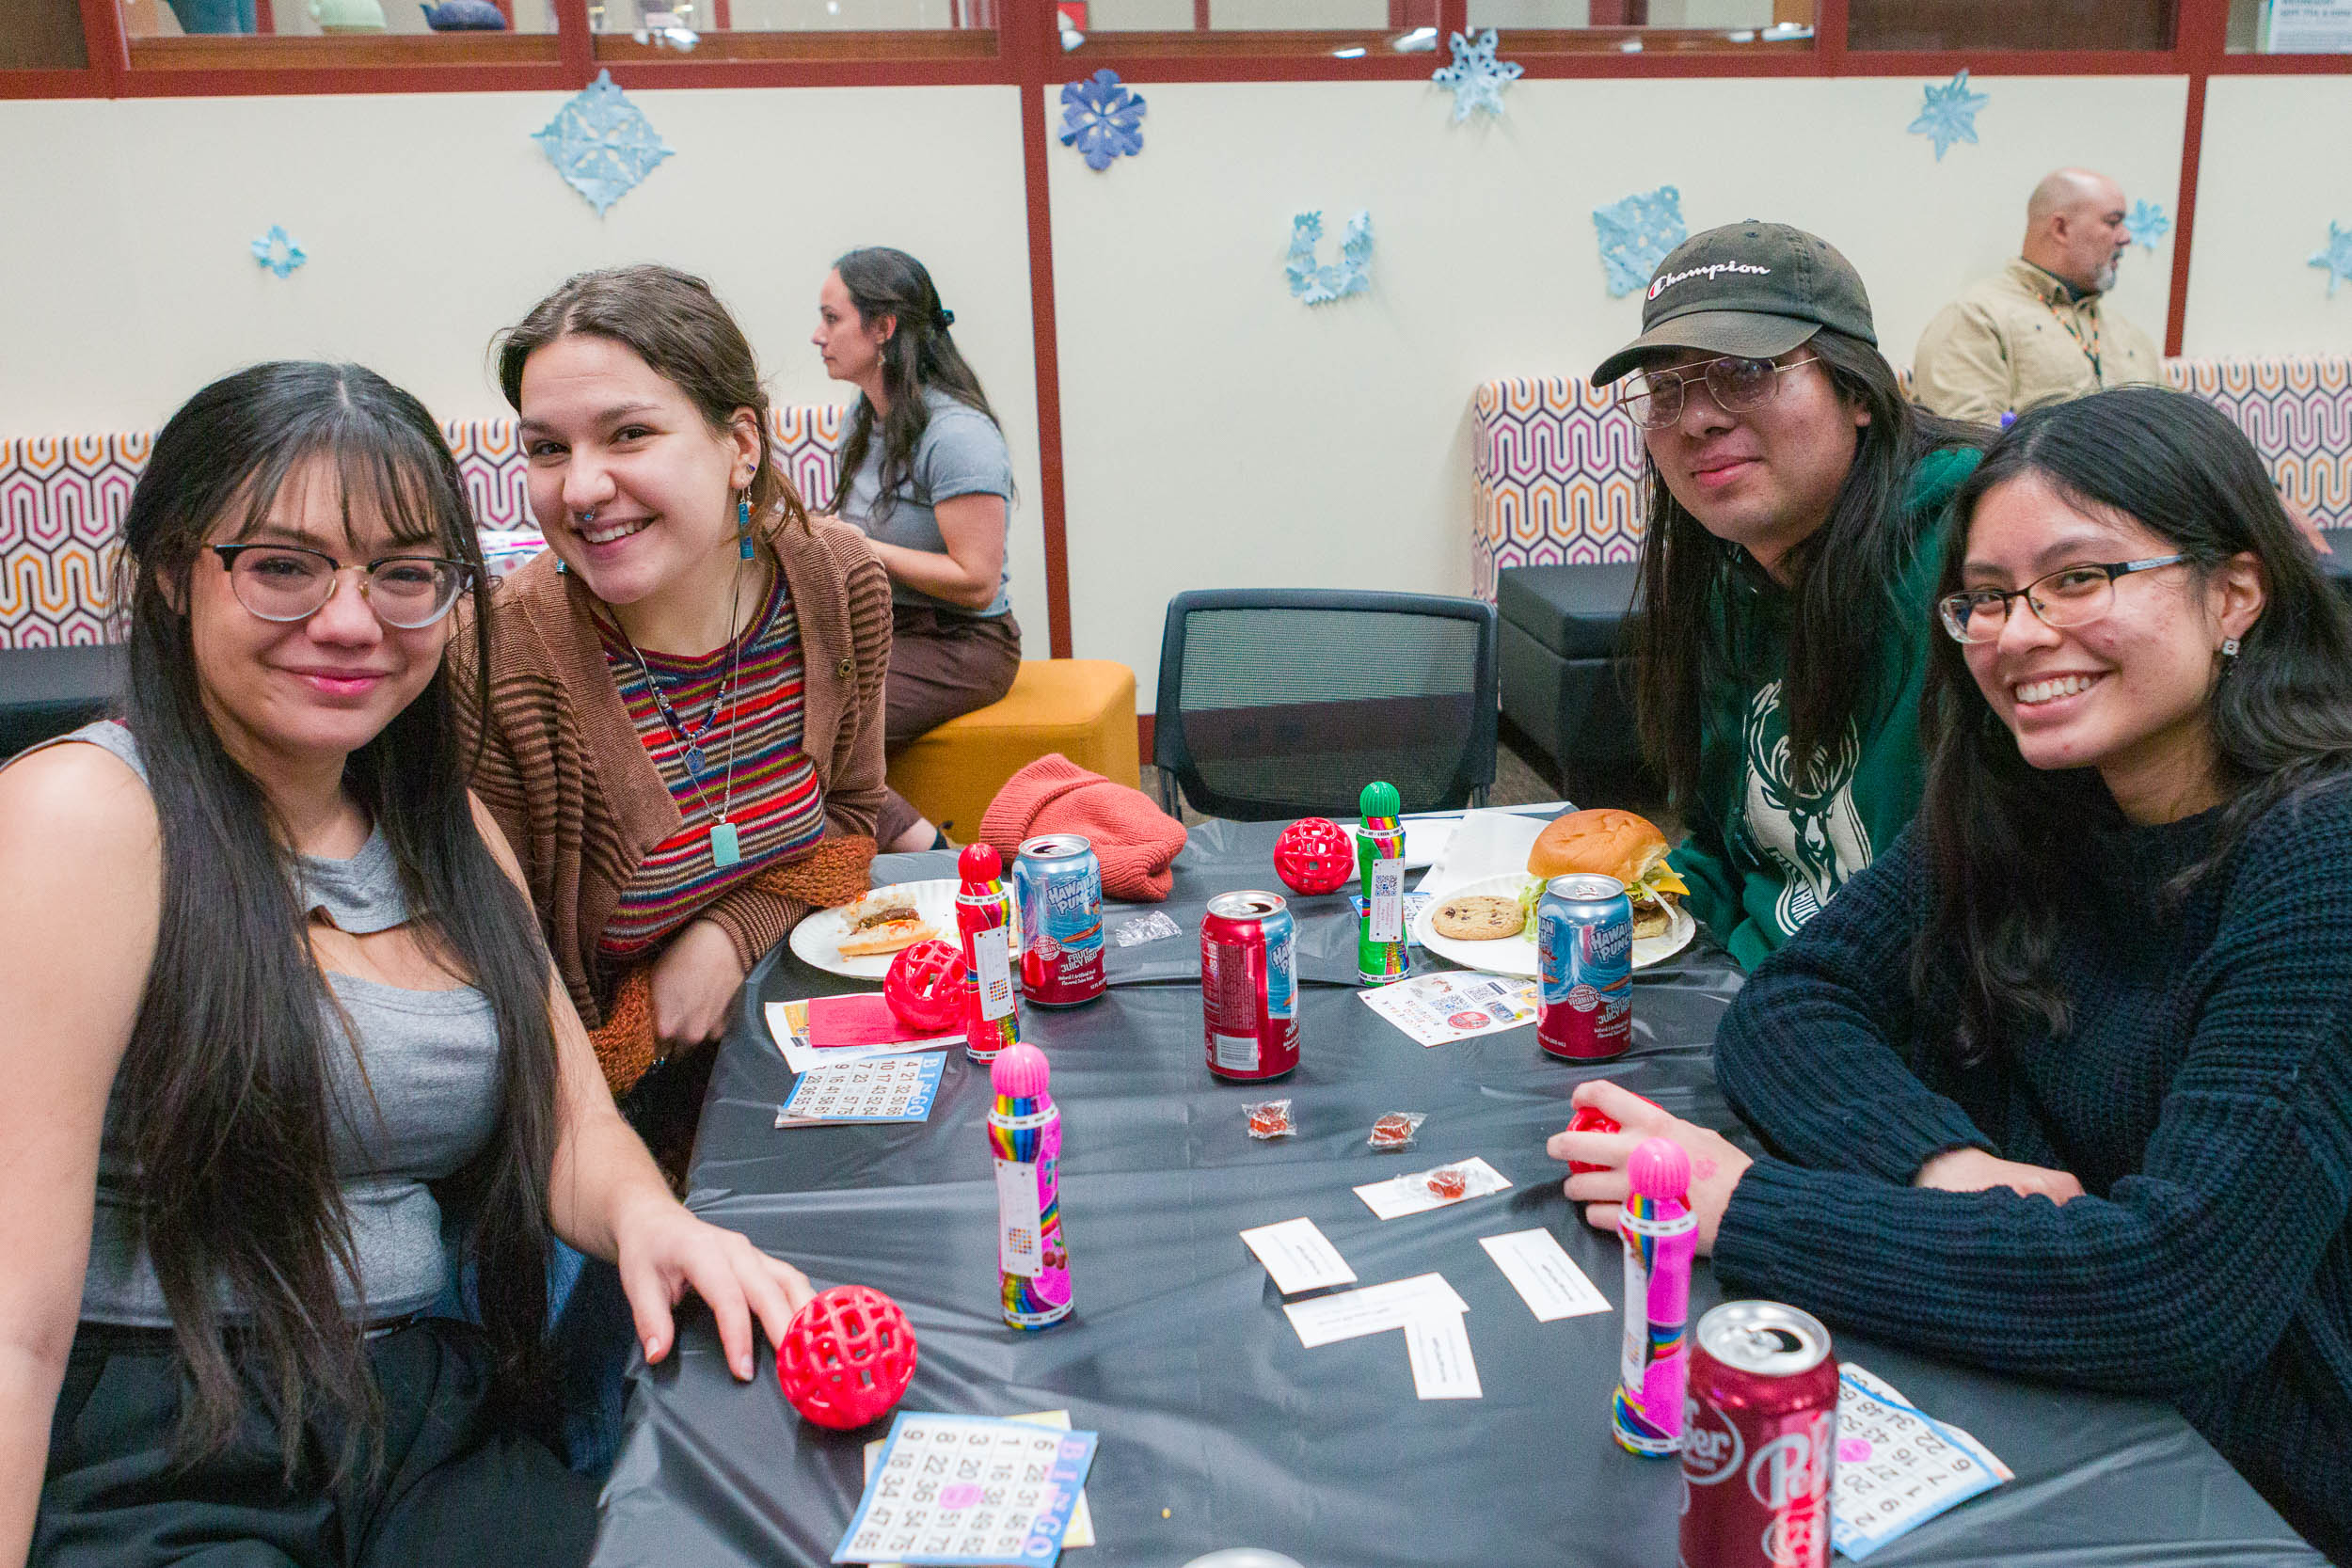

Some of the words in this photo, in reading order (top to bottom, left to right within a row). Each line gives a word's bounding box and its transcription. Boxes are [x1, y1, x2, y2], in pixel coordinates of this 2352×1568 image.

[1647, 260, 1771, 301] Champion
[1068, 947, 1089, 963] FRUIT
[1060, 958, 1084, 974] JUICY
[1084, 950, 1097, 964] RED
[880, 1061, 895, 1070] 10
[852, 1074, 868, 1083] 23
[877, 1074, 891, 1084] 17
[900, 1072, 915, 1082] 21
[801, 1085, 818, 1095] 36
[872, 1085, 887, 1095] 43
[896, 1085, 911, 1094] 32
[907, 1057, 940, 1117] BINGO
[843, 1096, 860, 1105] 57
[866, 1096, 883, 1105] 52
[891, 1096, 908, 1105] 50
[903, 1429, 924, 1441] 9
[935, 1432, 957, 1444] 8
[968, 1434, 990, 1446] 3
[1001, 1438, 1021, 1447] 1
[1033, 1440, 1054, 1451] 6
[1915, 1432, 1947, 1454] 22
[1892, 1448, 1917, 1467] 16
[923, 1454, 949, 1476] 22
[957, 1459, 981, 1480] 20
[1951, 1459, 1971, 1471] 6
[1867, 1465, 1899, 1481] 27
[1843, 1474, 1875, 1495] 20
[1927, 1473, 1947, 1486] 7
[879, 1476, 905, 1499] 34
[913, 1479, 939, 1504] 36
[1905, 1485, 1922, 1497] 1
[1024, 1438, 1088, 1559] BINGO
[1855, 1513, 1876, 1527] 2
